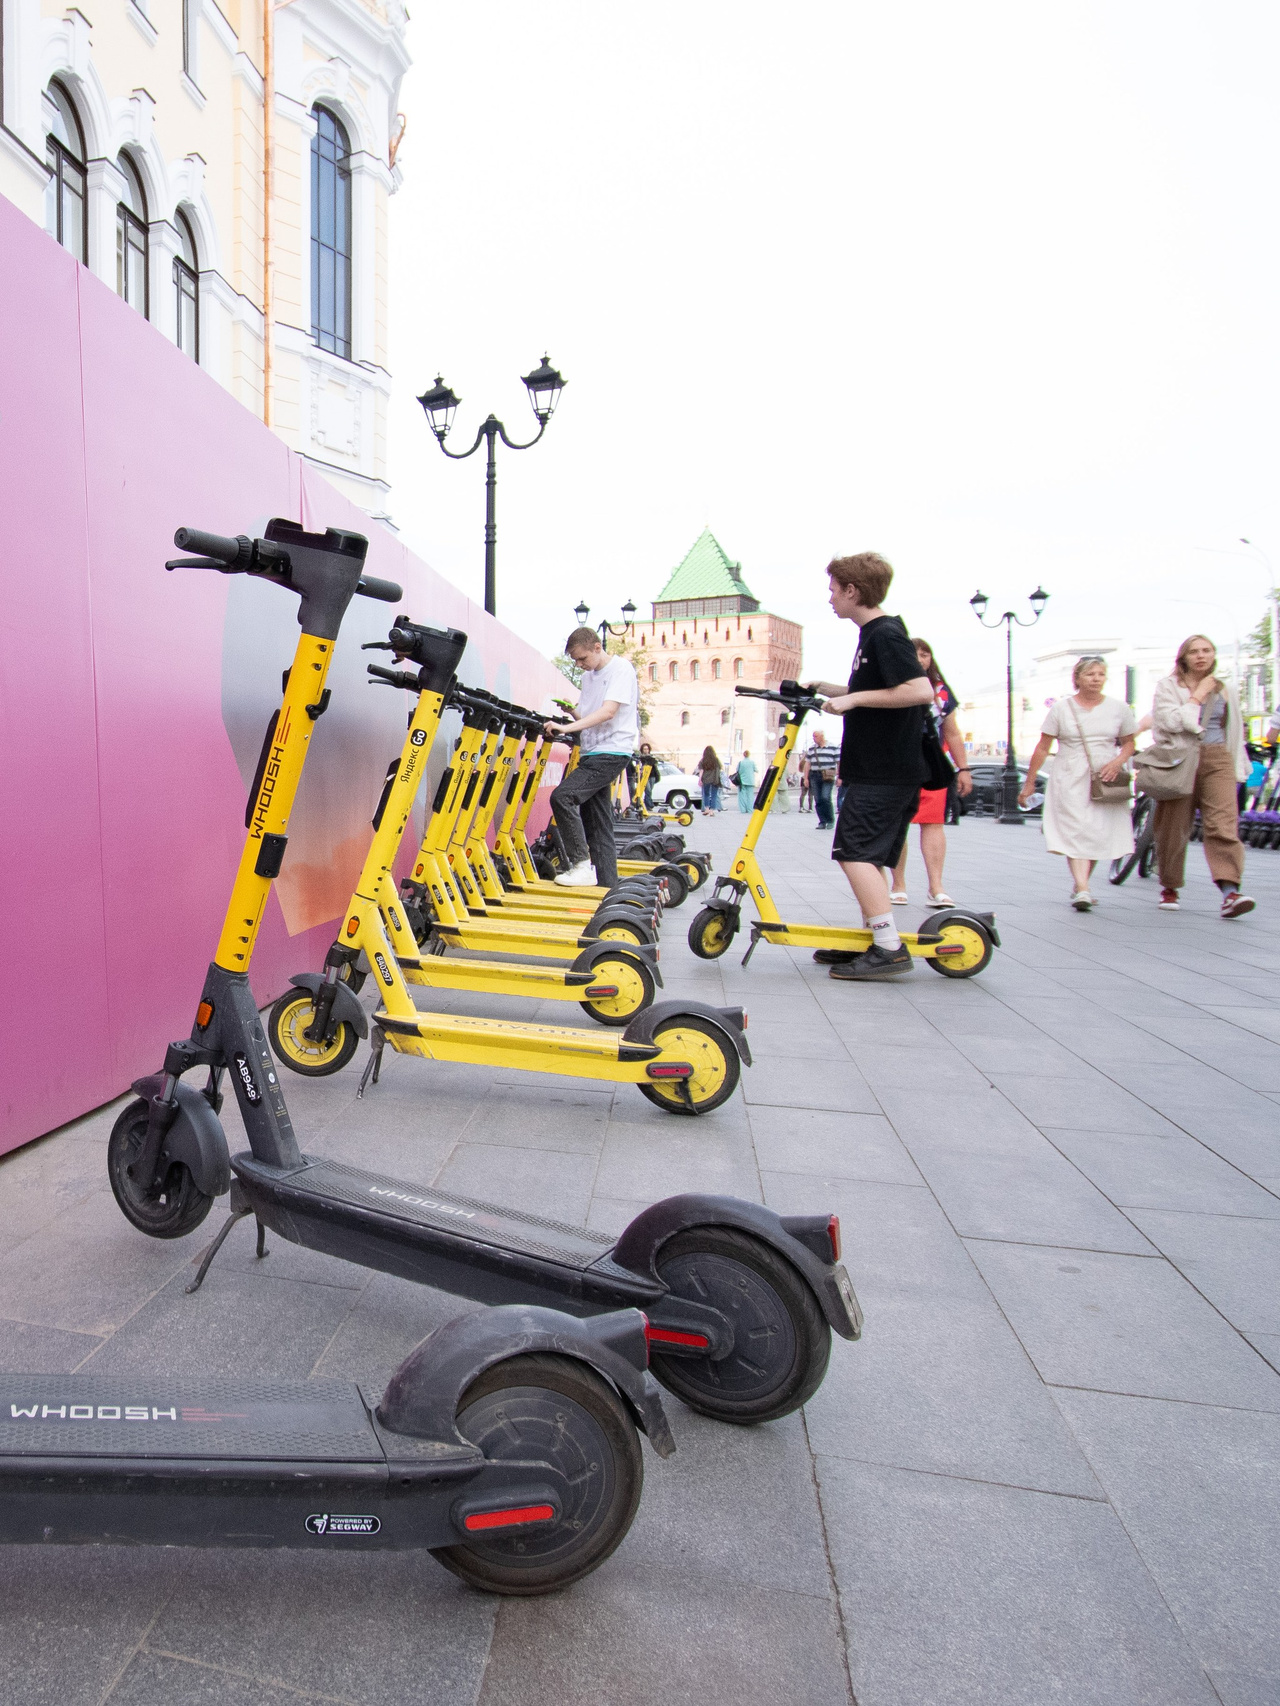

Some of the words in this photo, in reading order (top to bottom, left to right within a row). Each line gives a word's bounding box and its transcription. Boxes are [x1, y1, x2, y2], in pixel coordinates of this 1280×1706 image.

[400, 748, 420, 783] Яндекс
[412, 730, 426, 746] Go
[250, 746, 284, 840] WHOOSH
[376, 955, 393, 982] 840297
[368, 1186, 476, 1219] WHOOSH
[10, 1404, 177, 1421] WHOOSH
[330, 1523, 373, 1532] SEGWAY
